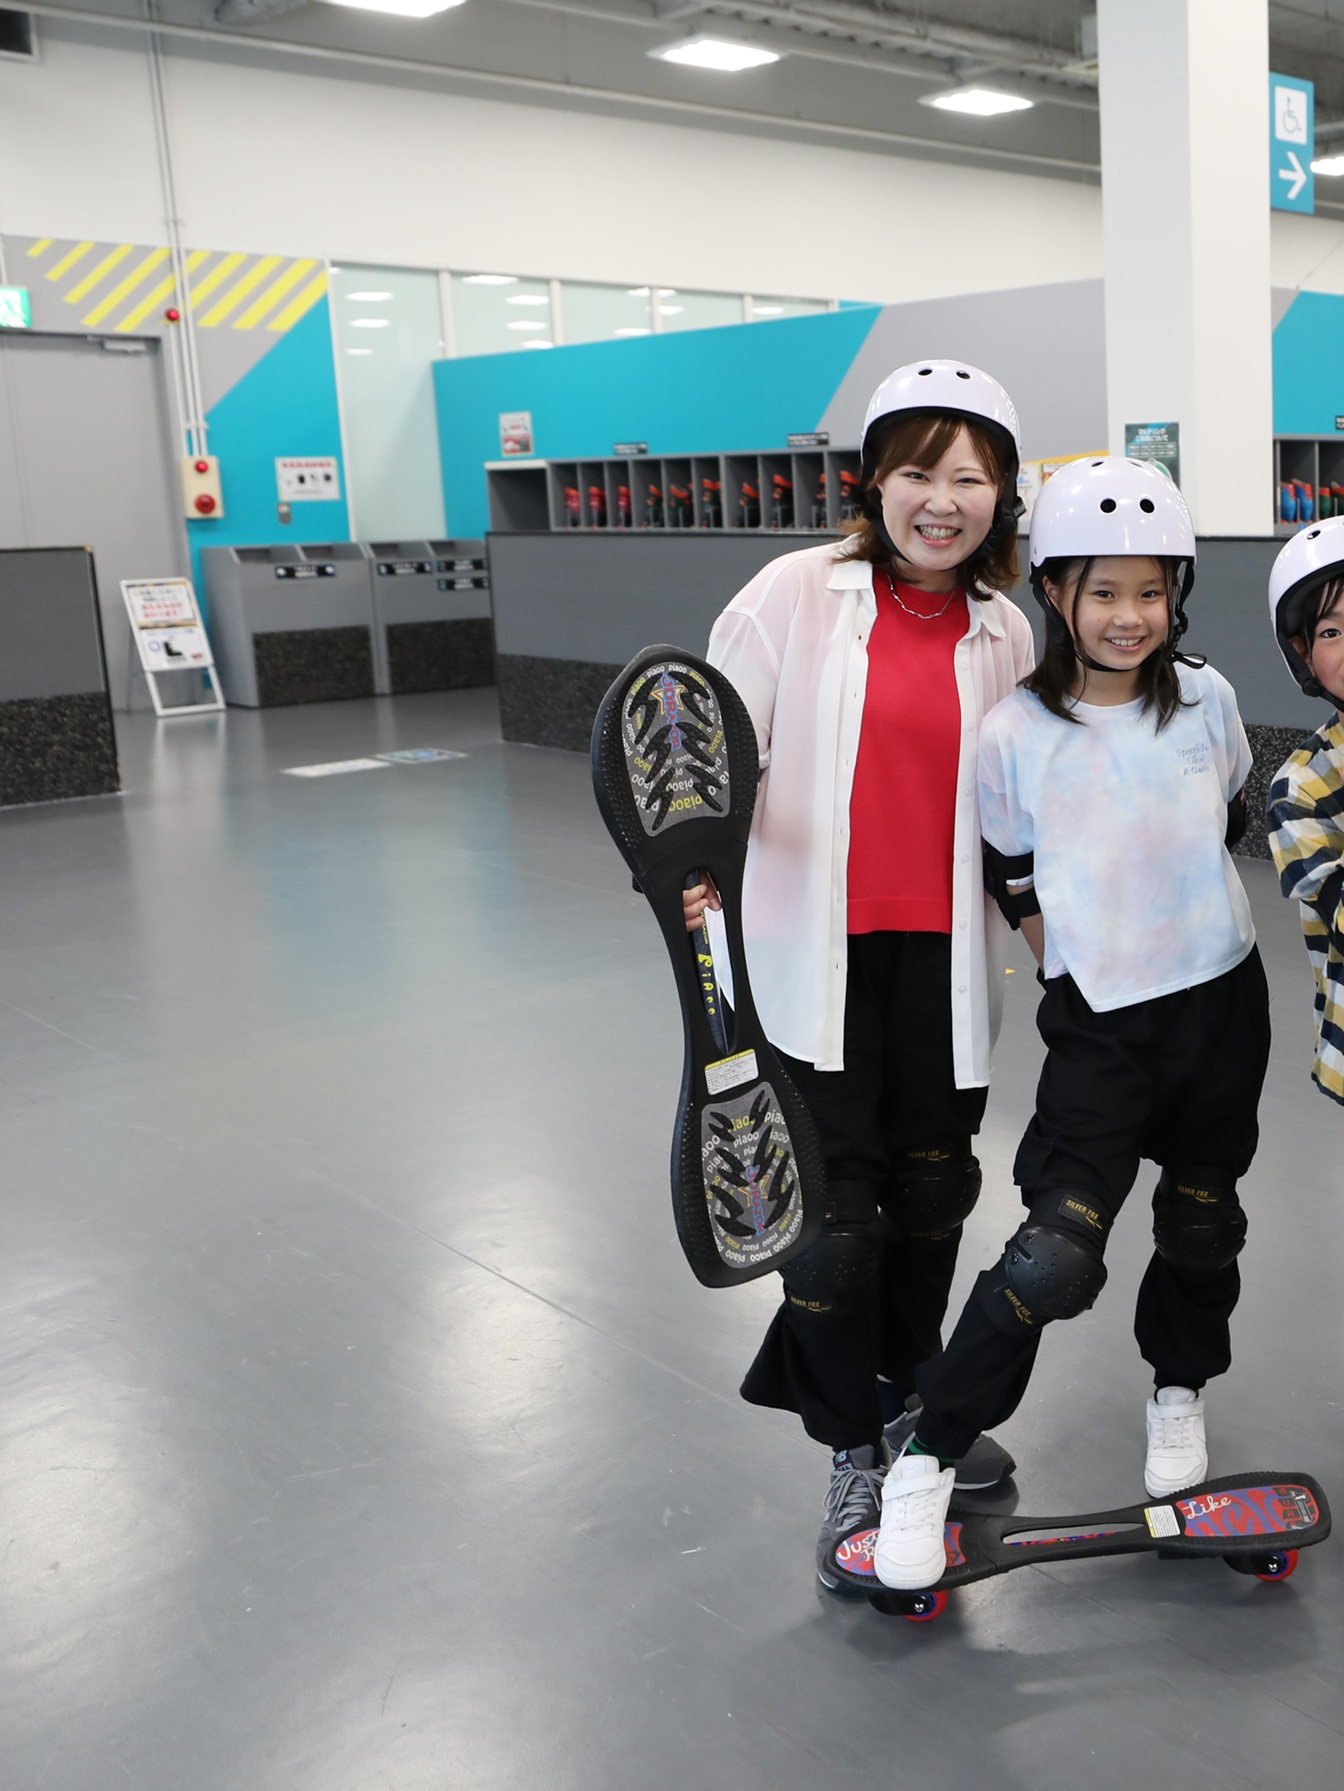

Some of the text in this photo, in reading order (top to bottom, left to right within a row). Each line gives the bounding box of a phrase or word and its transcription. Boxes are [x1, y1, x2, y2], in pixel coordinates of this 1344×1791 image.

[647, 666, 665, 678] piaoo
[668, 663, 687, 673] piaoo
[631, 677, 646, 695] piaoo
[709, 729, 723, 754] piaoo
[634, 757, 652, 774] iaoo
[727, 1115, 756, 1132] iao
[734, 1132, 759, 1148] piaoo
[769, 1128, 789, 1144] iaoo
[1066, 1200, 1099, 1220] SILVER FOX
[790, 1209, 803, 1232] piaoo
[773, 1232, 792, 1252] piaoo
[750, 1249, 772, 1262] piaoo
[1020, 1306, 1032, 1316] FOX
[1182, 1495, 1232, 1520] Like
